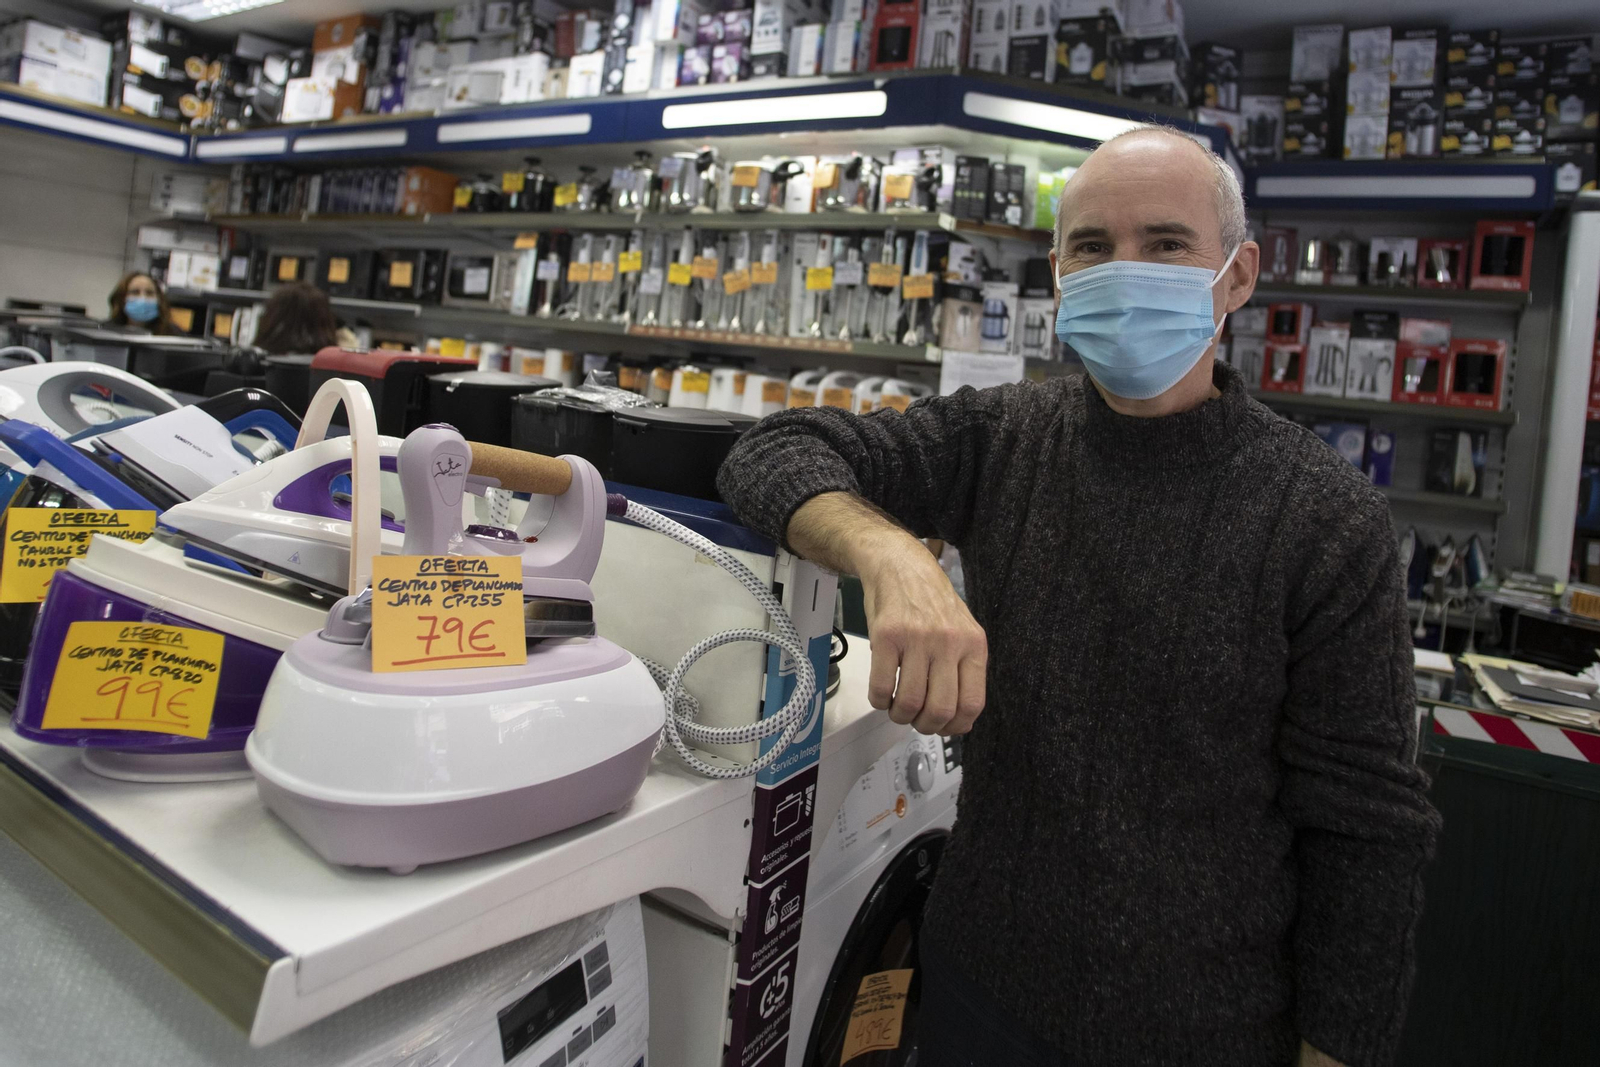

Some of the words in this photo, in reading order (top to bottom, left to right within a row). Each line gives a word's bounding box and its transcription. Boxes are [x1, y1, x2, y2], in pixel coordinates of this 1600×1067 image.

[50, 512, 119, 524] OFERTA
[18, 544, 73, 557] TAURUS
[419, 558, 489, 573] OFERTA
[378, 578, 437, 593] CENTRO
[387, 592, 433, 607] JATA
[119, 626, 183, 645] OFERTA
[416, 615, 496, 655] 79€
[68, 645, 123, 660] CENTRO
[128, 647, 149, 660] DE
[152, 649, 217, 673] PLANCHADO
[96, 658, 143, 675] JATA
[96, 676, 195, 720] 99€
[769, 752, 799, 775] Servicio
[760, 841, 789, 864] Accesorios
[751, 934, 779, 962] Productos
[779, 929, 787, 939] de
[741, 1023, 773, 1056] Ampliación
